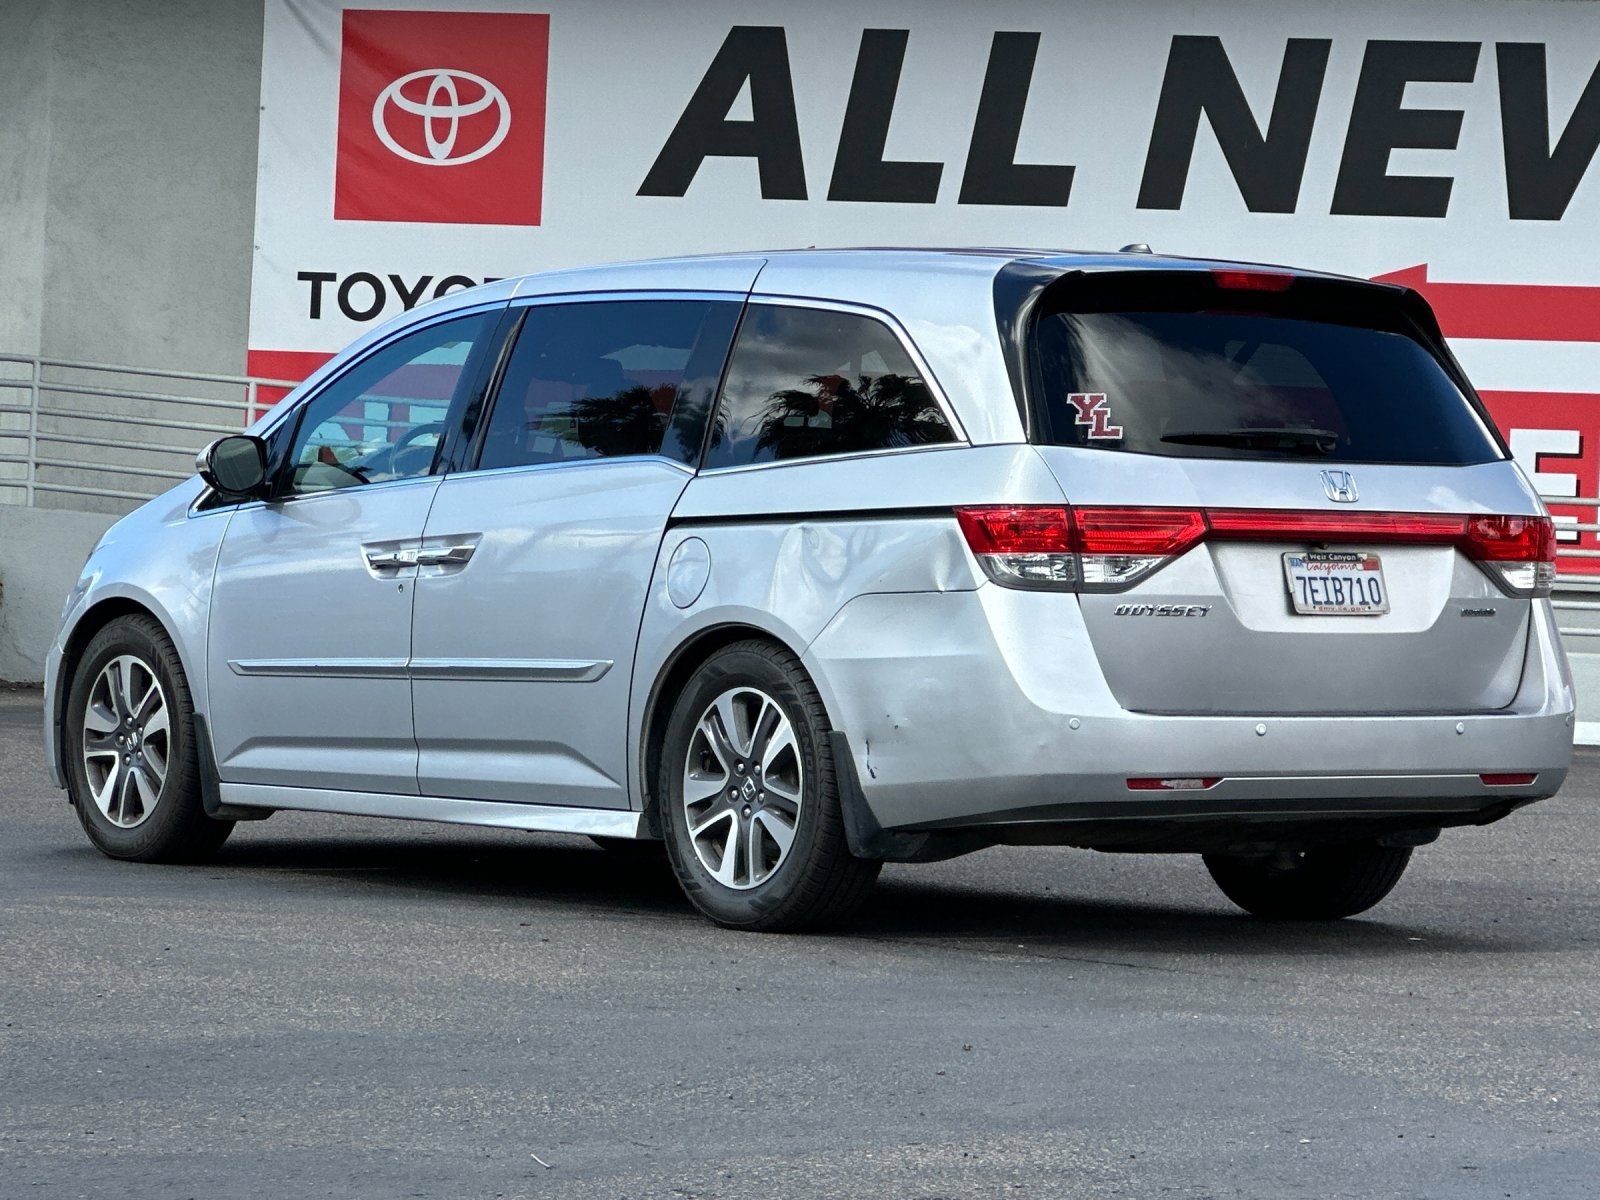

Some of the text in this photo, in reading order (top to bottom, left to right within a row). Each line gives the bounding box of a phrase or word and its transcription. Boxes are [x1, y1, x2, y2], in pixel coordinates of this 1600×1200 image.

[637, 25, 1077, 207] ALL
[1309, 553, 1357, 562] Weir Canyon
[1296, 576, 1382, 606] 7EIB710
[1114, 603, 1212, 617] ODYSSEY
